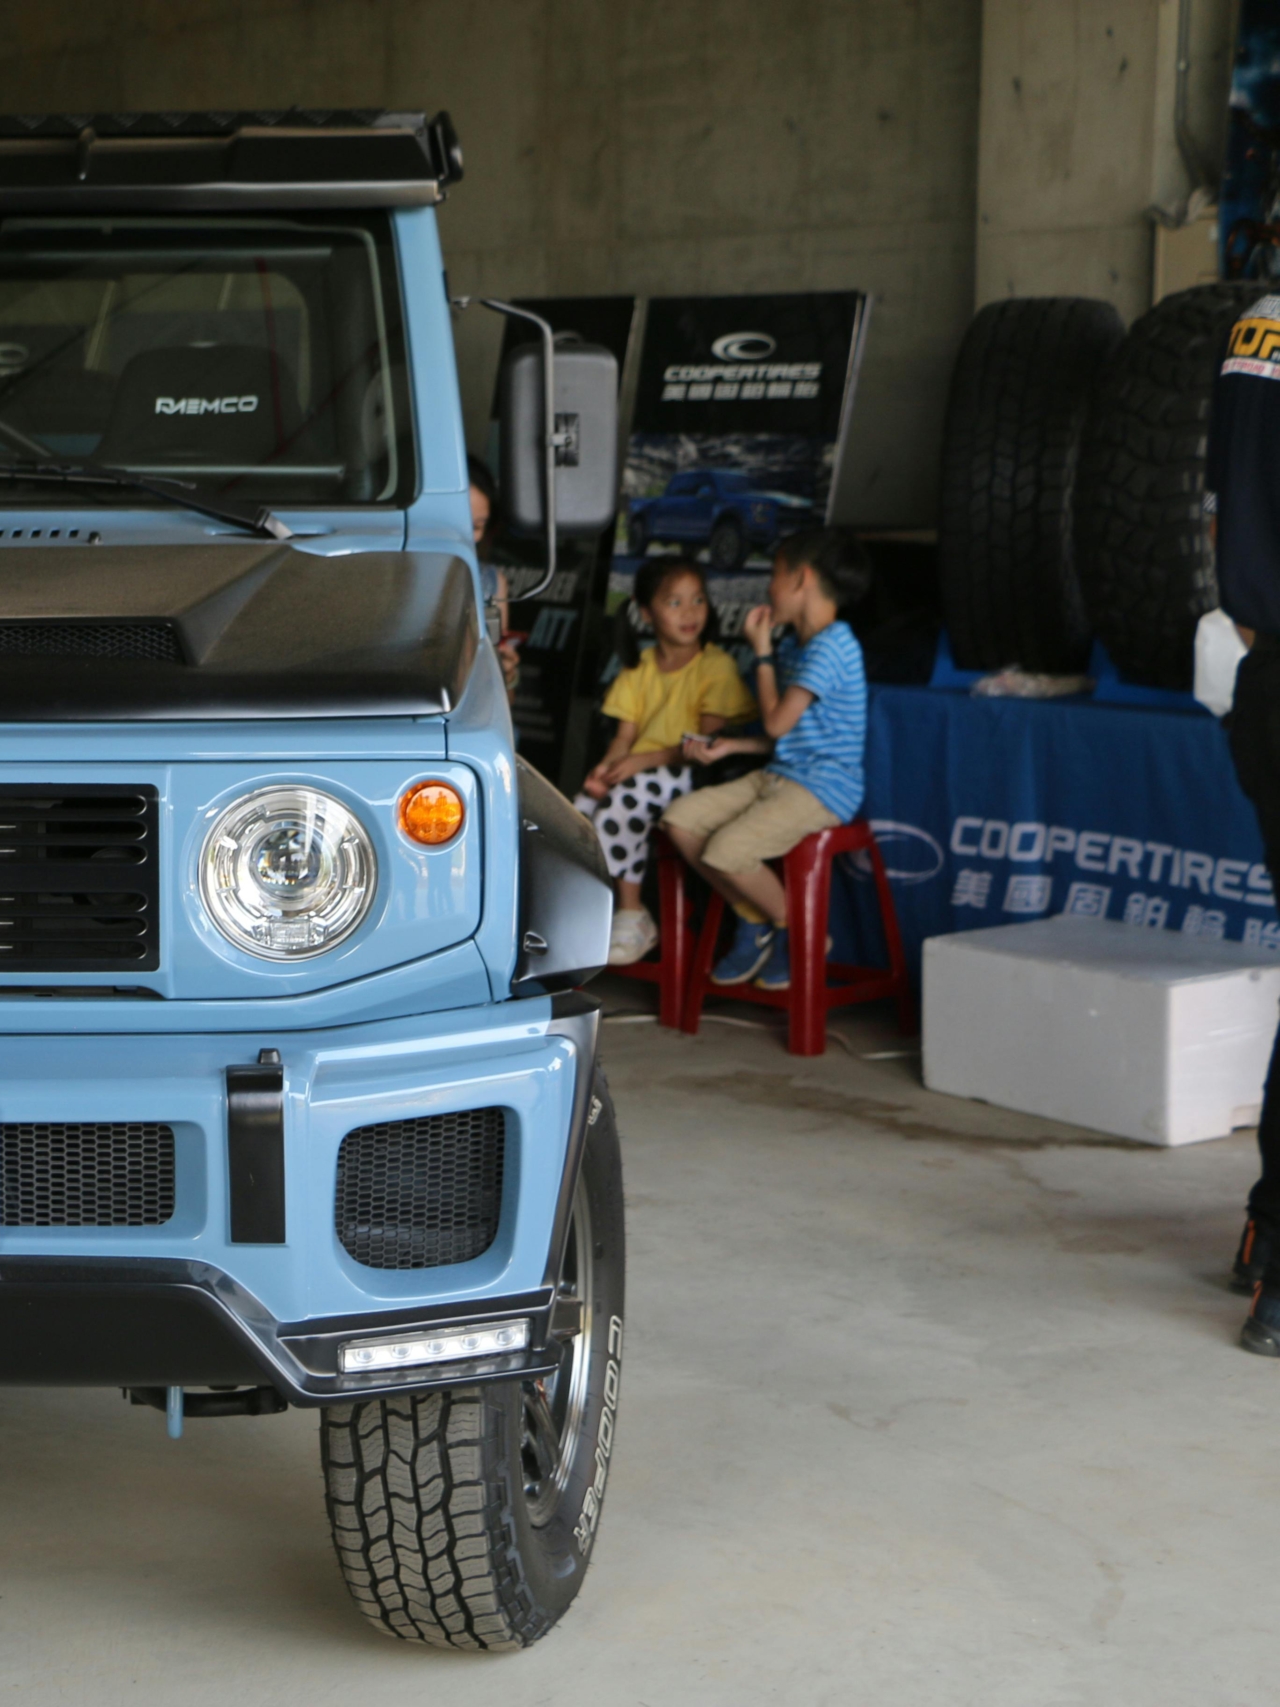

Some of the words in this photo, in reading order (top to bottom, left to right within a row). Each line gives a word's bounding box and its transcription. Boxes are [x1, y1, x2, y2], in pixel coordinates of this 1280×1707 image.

[154, 394, 259, 417] RAEMCO
[949, 815, 1278, 906] COOPERTIRES
[572, 1314, 624, 1557] COOPER
